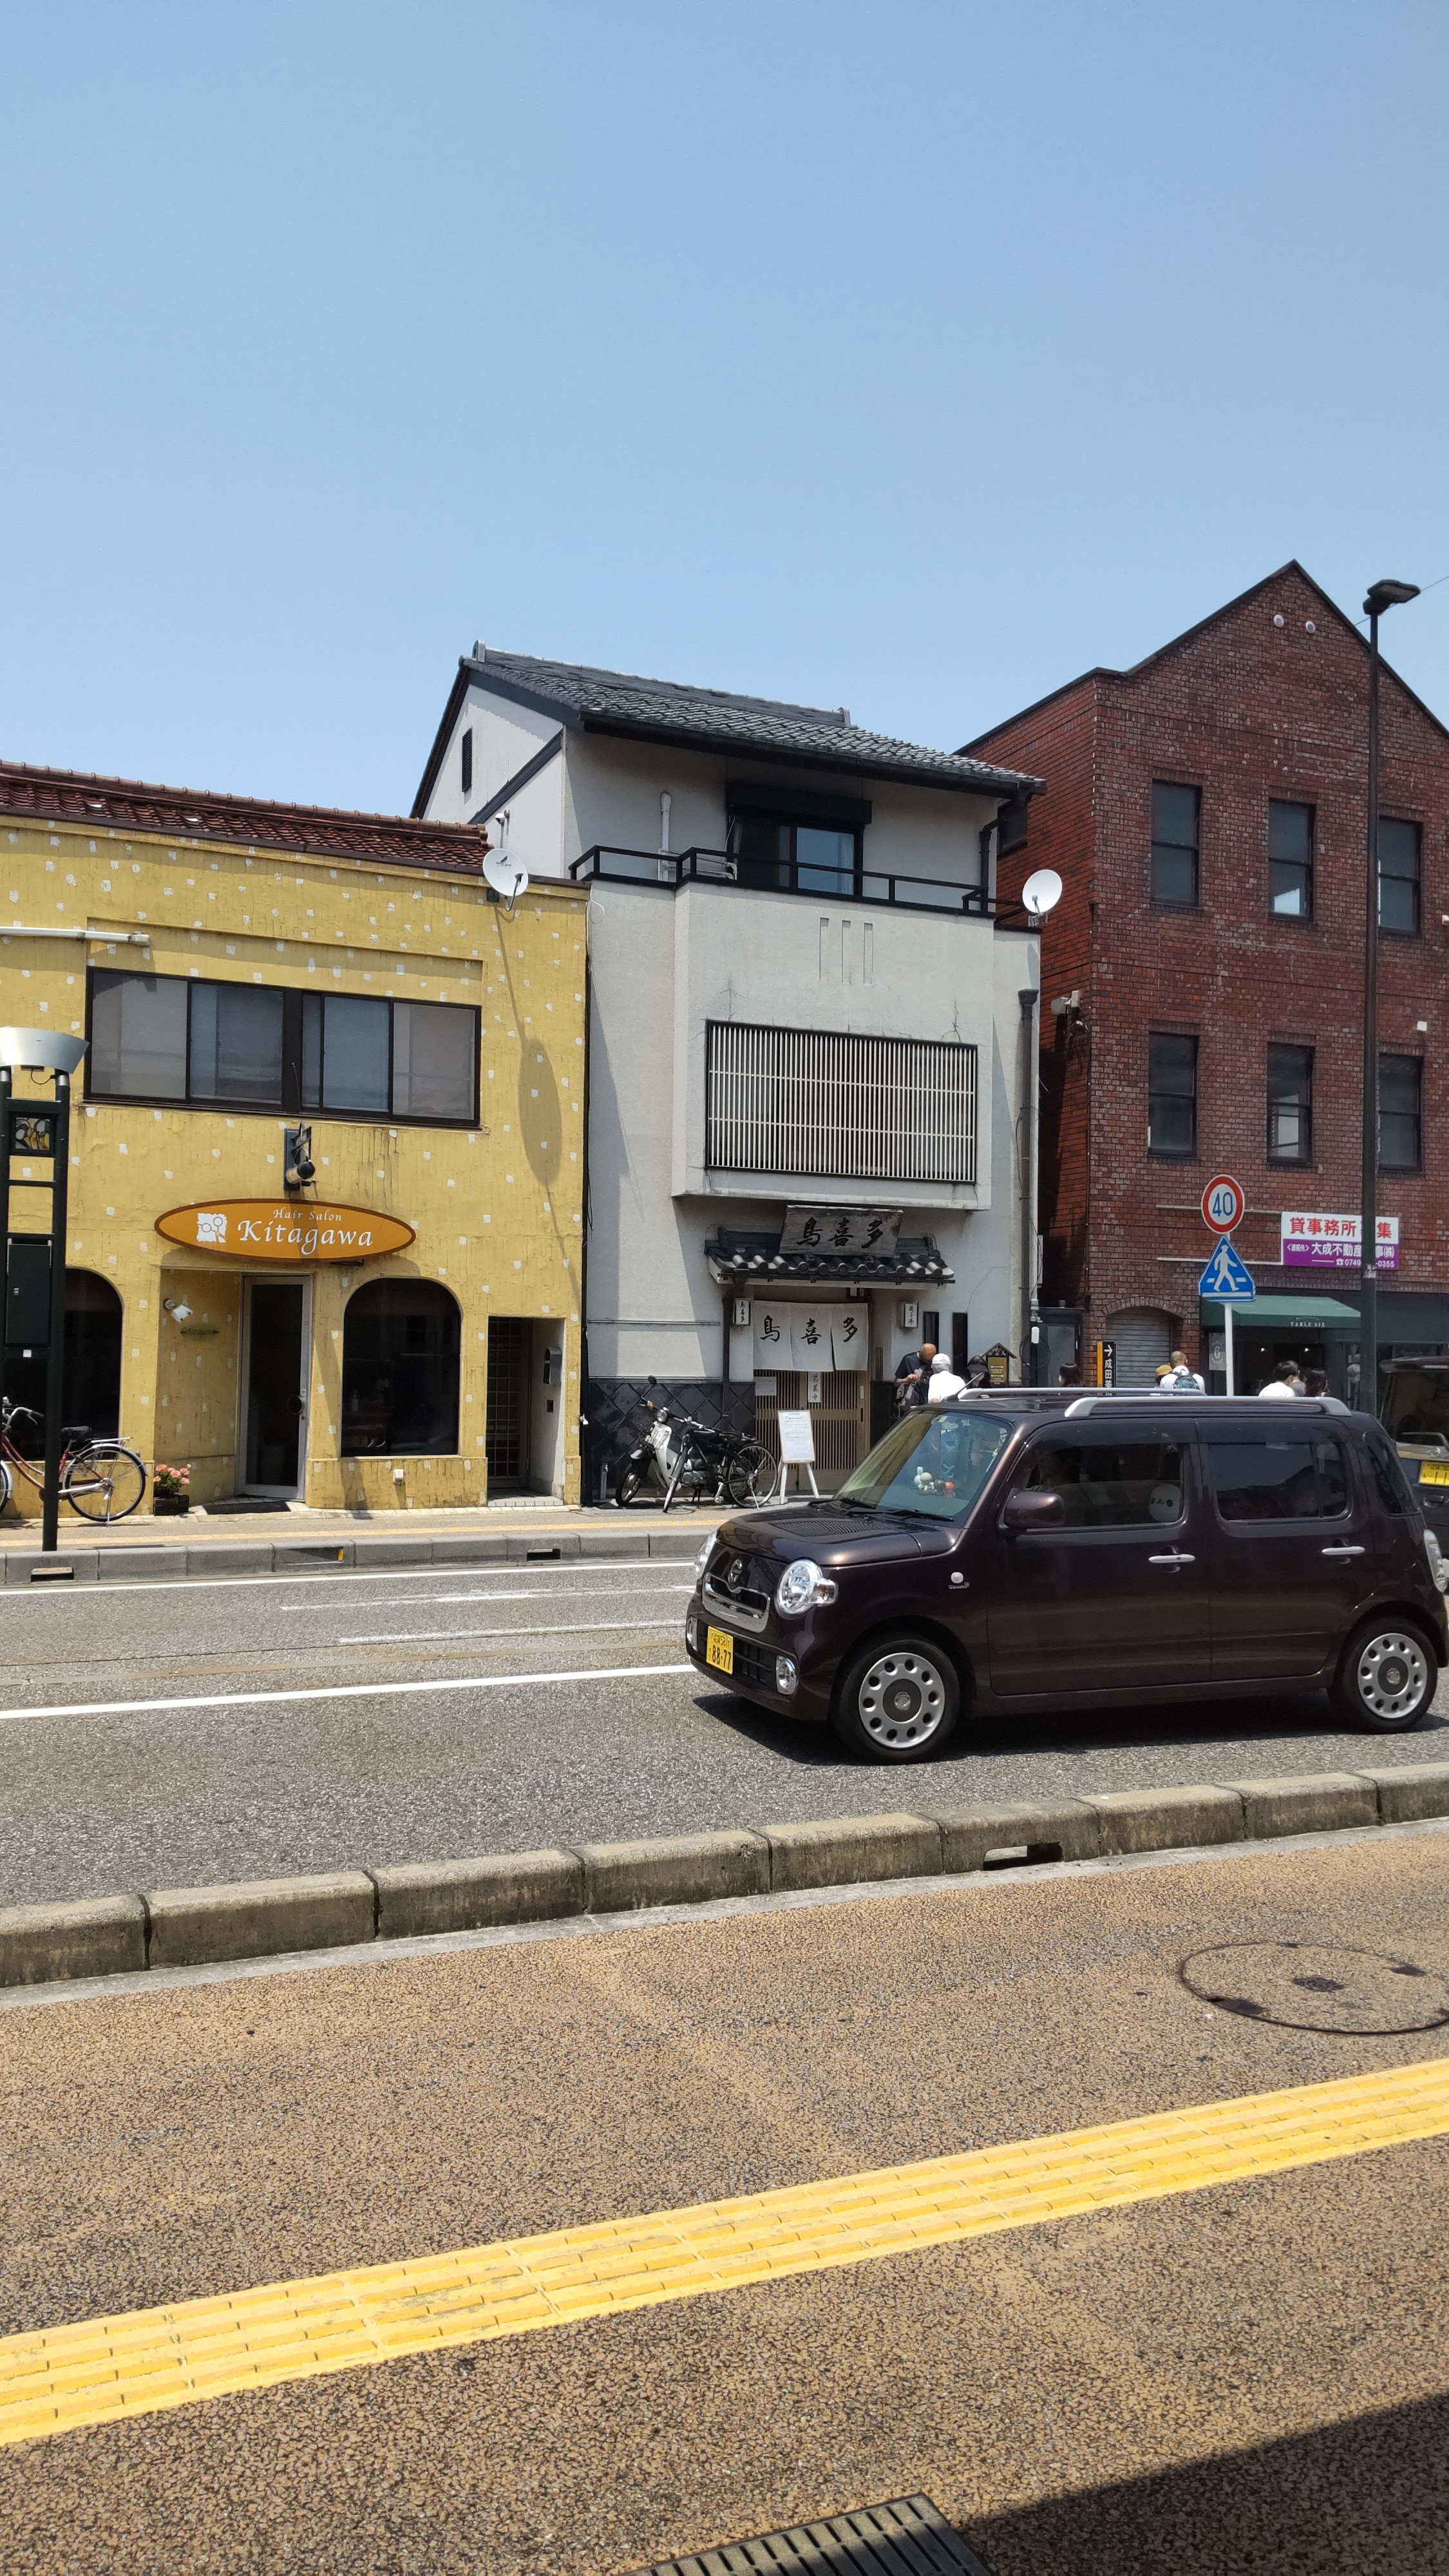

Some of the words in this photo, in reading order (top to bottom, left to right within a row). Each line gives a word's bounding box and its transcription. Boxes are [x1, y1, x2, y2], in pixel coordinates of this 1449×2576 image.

[273, 1207, 303, 1218] Hair
[309, 1210, 343, 1222] Salon
[1212, 1191, 1233, 1217] 40
[237, 1220, 373, 1255] Kitagawa
[1289, 1217, 1392, 1239] 貸事務所集
[1311, 1242, 1395, 1258] 大成不動産事(株)
[1214, 1345, 1220, 1359] 6
[1104, 1358, 1113, 1396] 成田美
